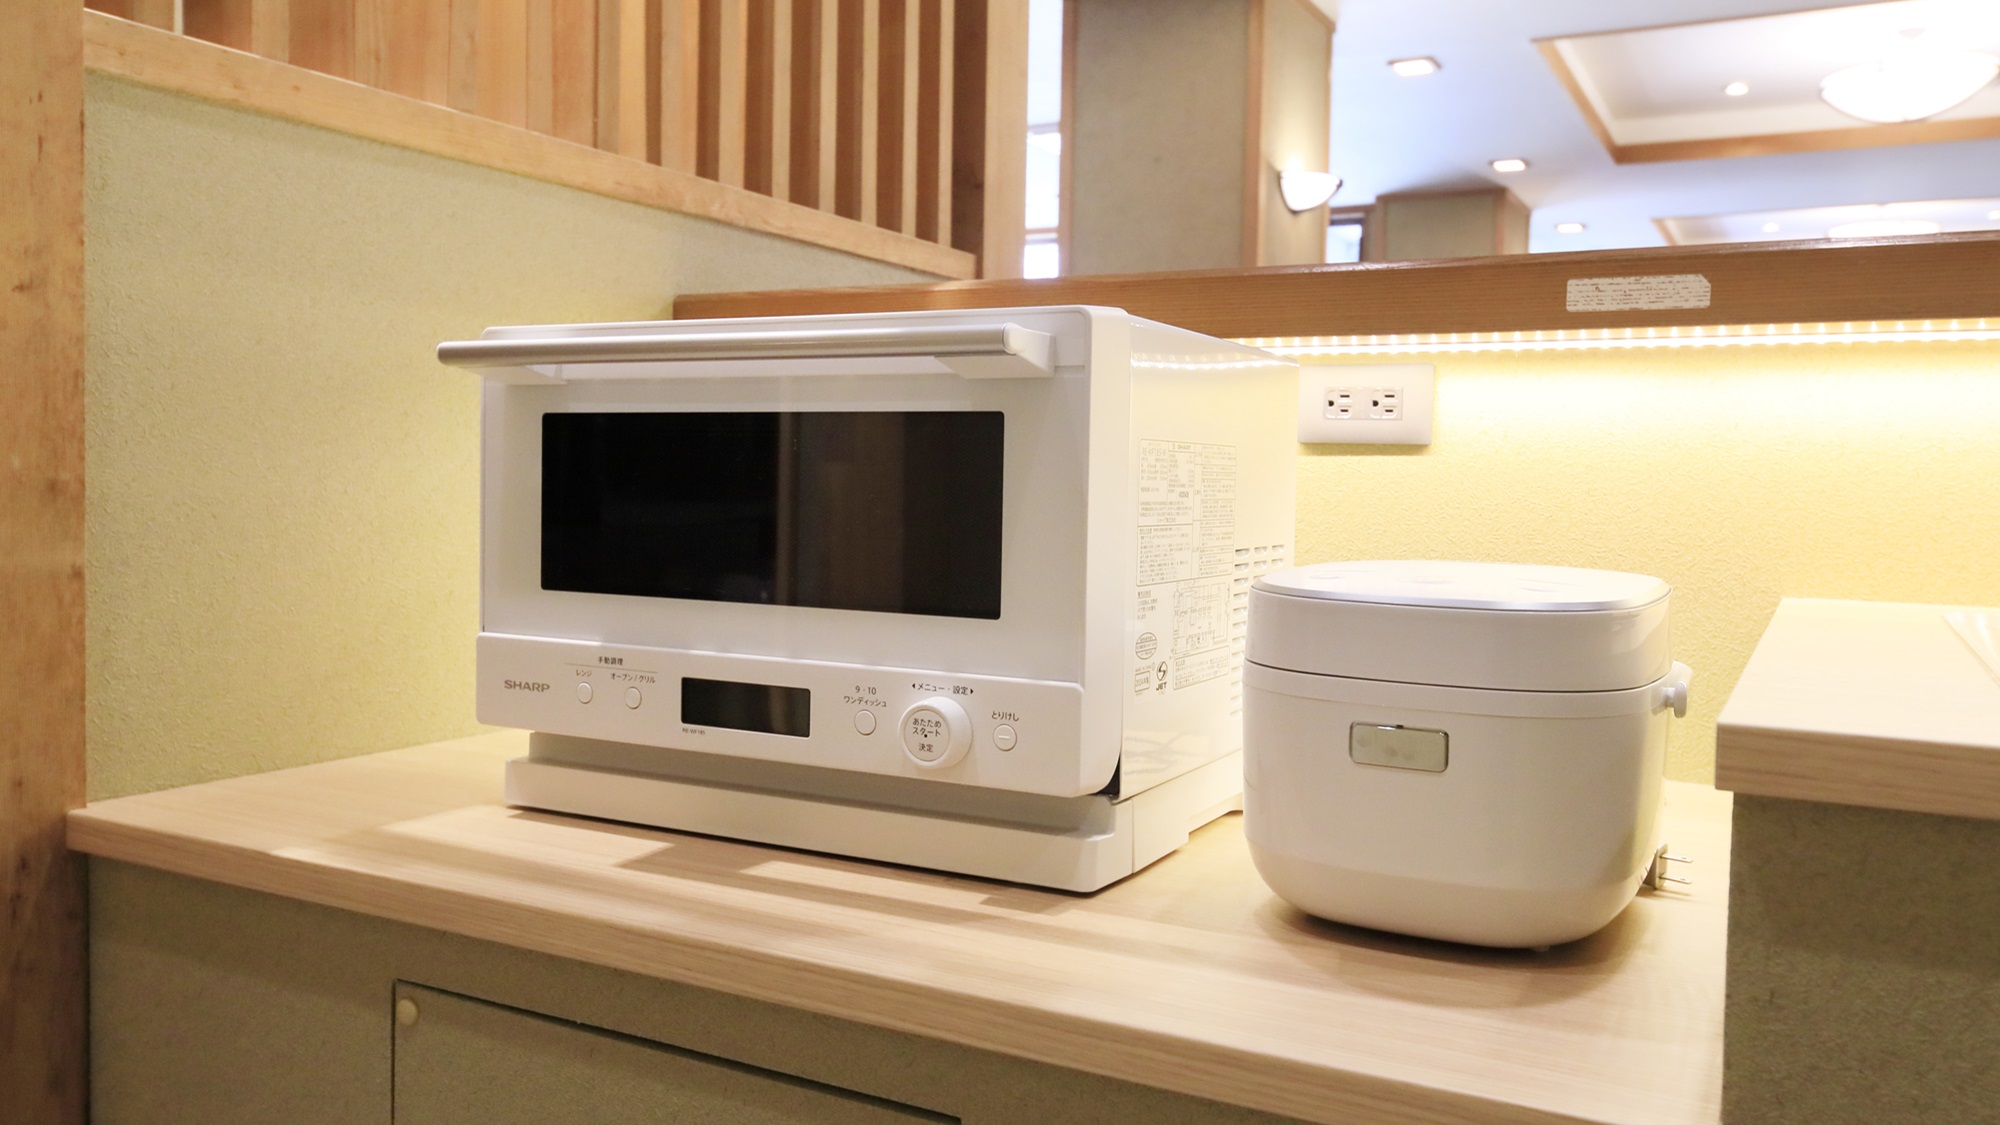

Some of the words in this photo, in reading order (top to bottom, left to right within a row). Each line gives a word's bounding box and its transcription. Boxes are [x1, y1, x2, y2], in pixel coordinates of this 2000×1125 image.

[598, 656, 623, 666] 手動調理
[576, 669, 592, 677] レンジ
[504, 679, 550, 693] SHARP
[1156, 682, 1167, 691] JET
[844, 695, 887, 707] ワンディッシュ
[991, 710, 1020, 722] とりけし
[912, 717, 942, 728] あたため
[912, 726, 941, 737] スタート
[918, 743, 934, 752] 決定
